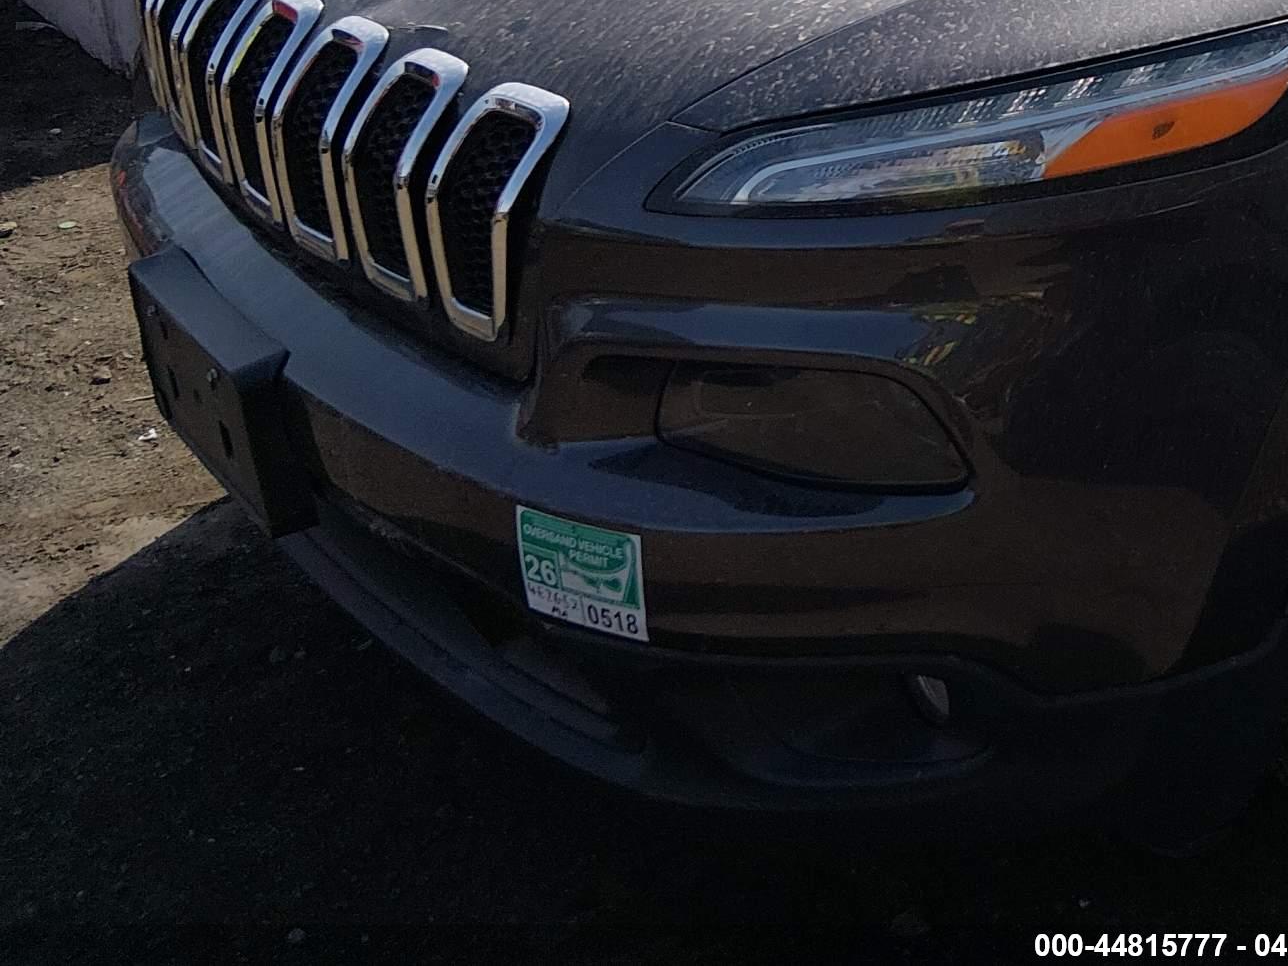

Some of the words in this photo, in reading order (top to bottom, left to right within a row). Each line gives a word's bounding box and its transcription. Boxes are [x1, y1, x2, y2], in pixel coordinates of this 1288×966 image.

[568, 548, 609, 568] PERMIT
[579, 540, 623, 560] VEHICLE
[524, 554, 558, 587] 26
[587, 604, 638, 635] 0518
